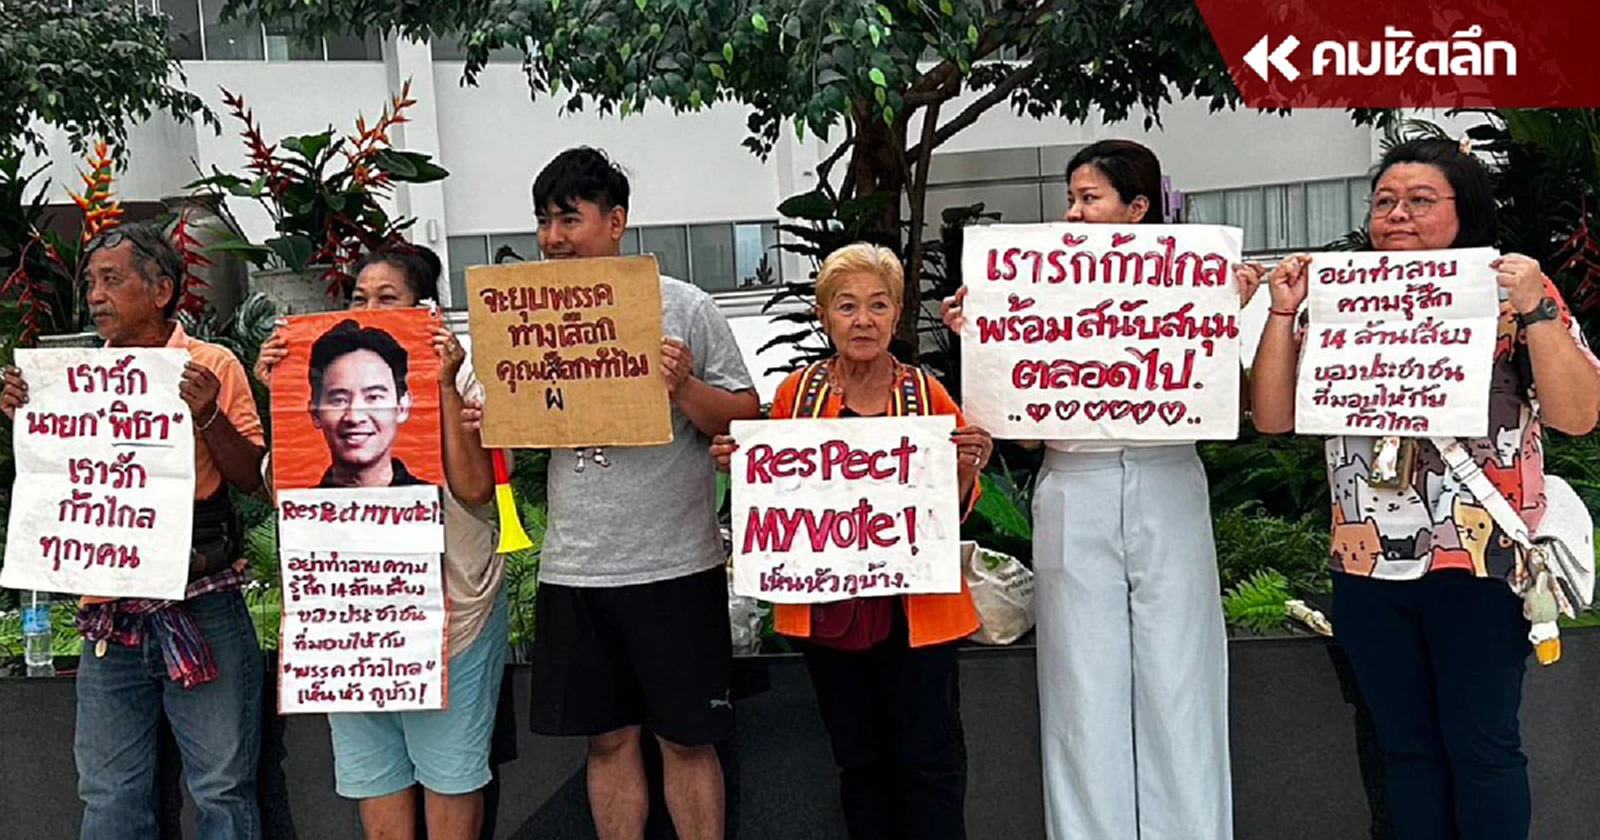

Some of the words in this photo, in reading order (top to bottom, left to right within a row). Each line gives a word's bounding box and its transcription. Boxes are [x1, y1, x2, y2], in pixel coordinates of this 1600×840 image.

[1317, 256, 1457, 284] อย่าทำลาย
[480, 283, 614, 323] จะยุบพรรค
[1337, 282, 1452, 321] ความรู้สึก
[508, 312, 617, 349] ทางเลือก
[1319, 328, 1347, 349] 14
[1354, 316, 1472, 346] ล้านเสียง
[66, 355, 148, 395] เรารัก
[1312, 381, 1447, 408] ที่มอบให้กับ
[1345, 407, 1430, 432] ก้าวไกล
[68, 452, 147, 488] เรารัก
[58, 489, 157, 528] ก้าวไกล
[39, 536, 141, 571] ทุกๆคน
